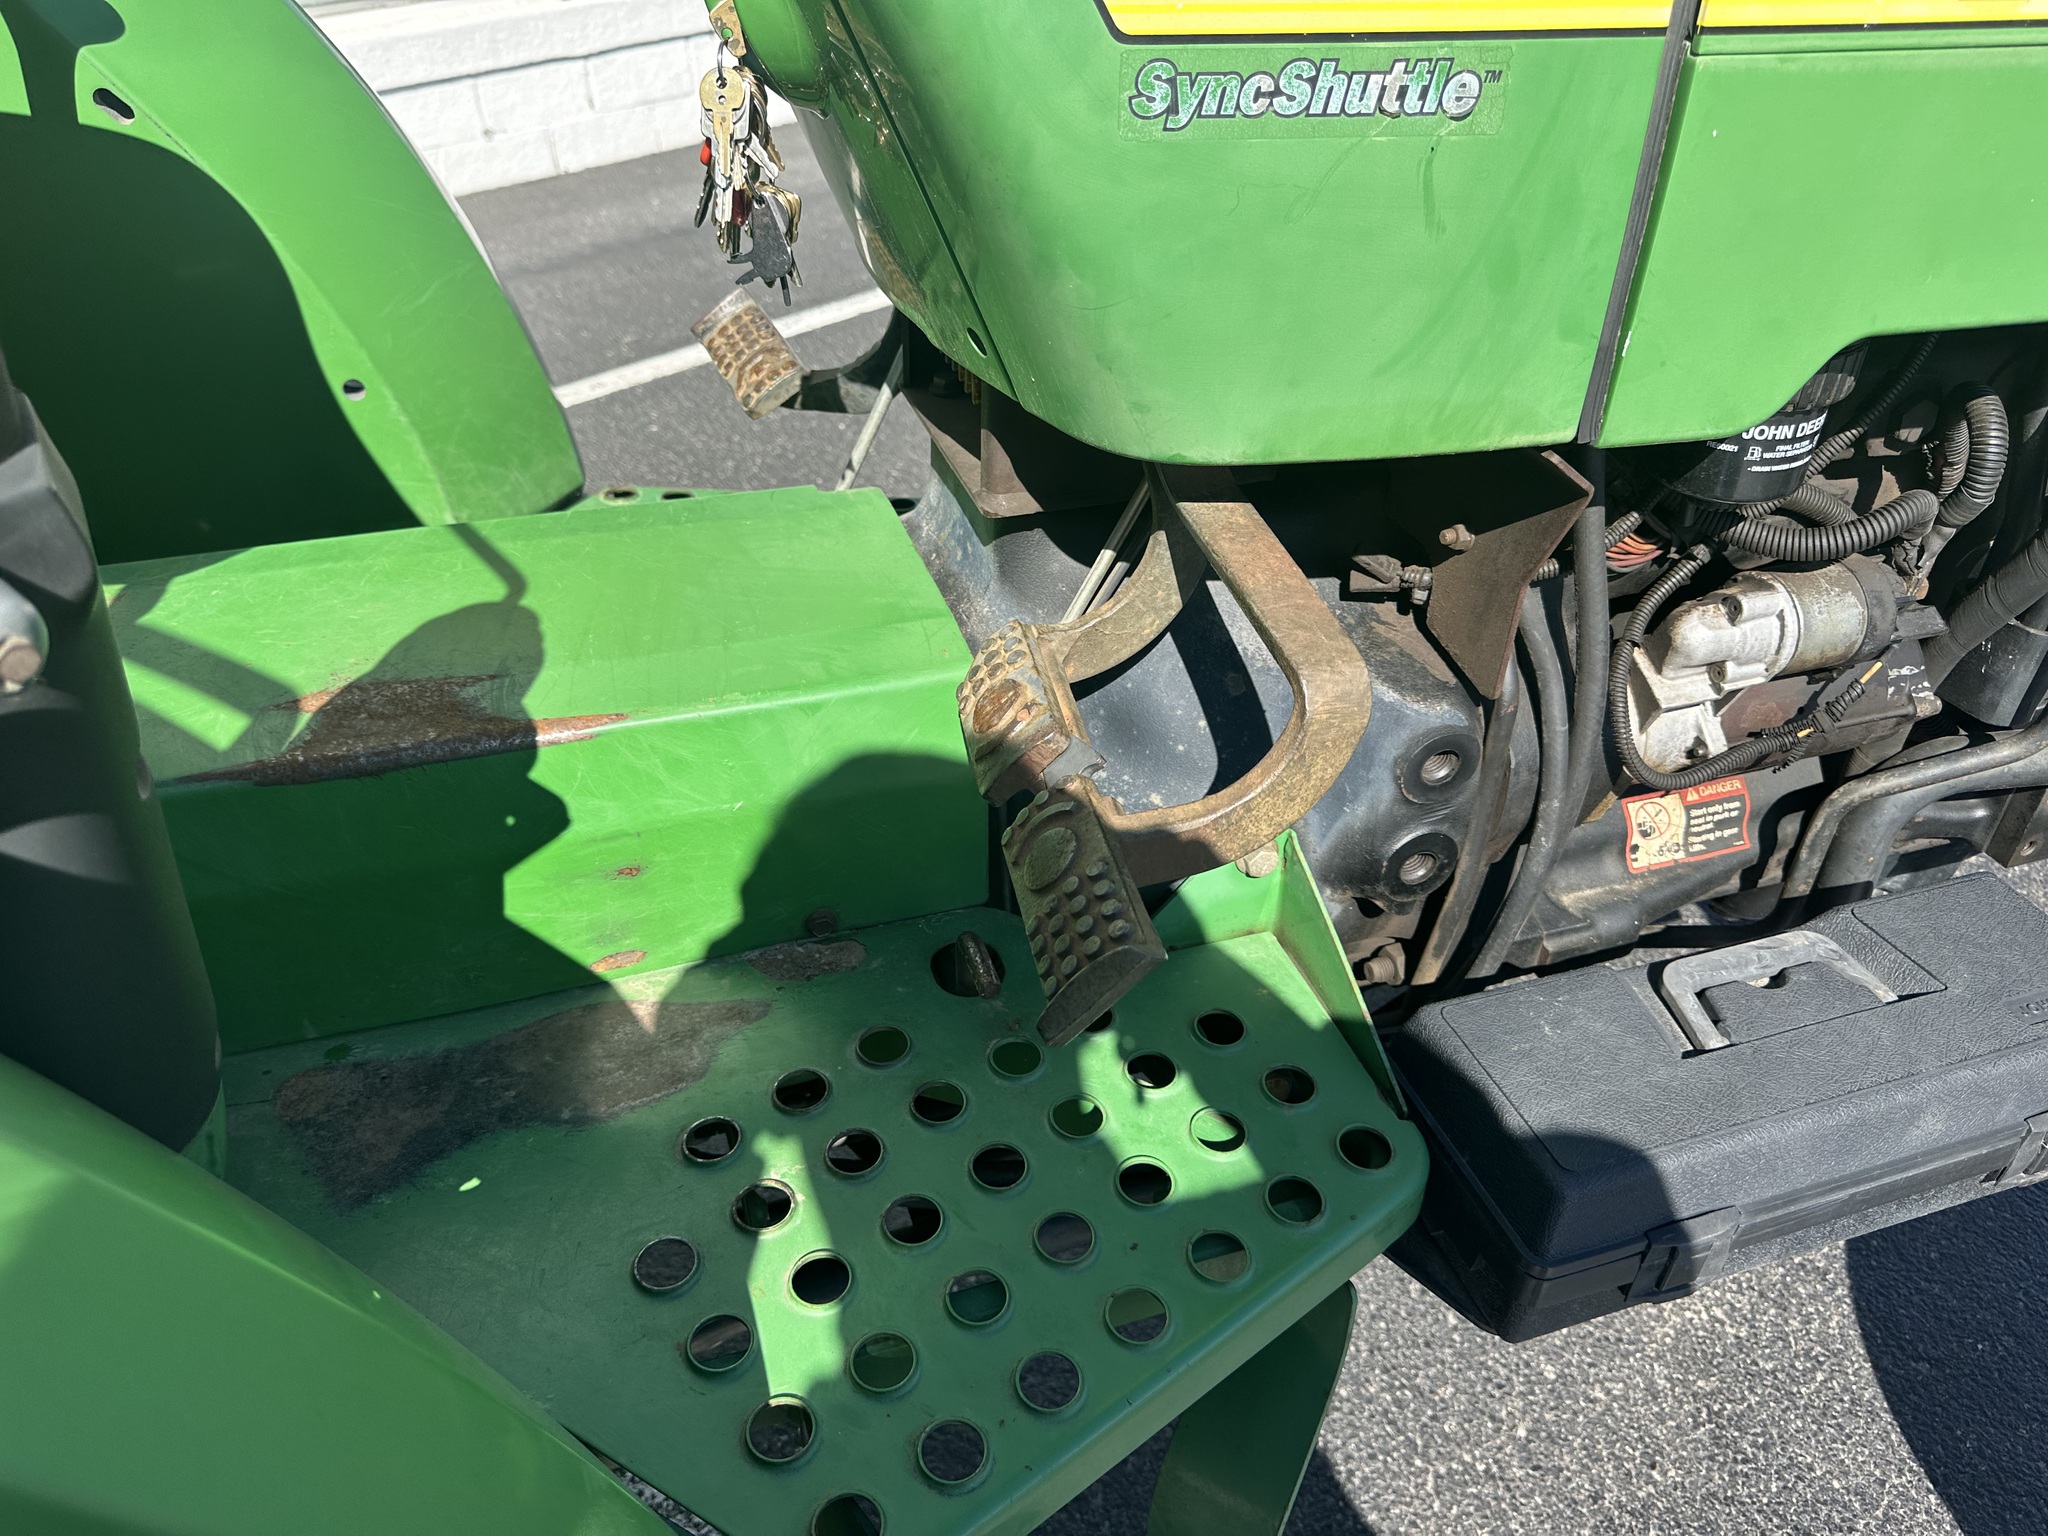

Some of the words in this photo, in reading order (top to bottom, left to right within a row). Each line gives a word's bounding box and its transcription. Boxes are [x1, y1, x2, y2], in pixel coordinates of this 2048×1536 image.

[1129, 57, 1482, 131] SyncShuttle
[1741, 424, 1796, 440] JOHN
[1763, 451, 1785, 459] WATER
[1775, 444, 1793, 452] FINAL
[1699, 780, 1741, 796] DANGER
[1690, 807, 1707, 817] Start
[1707, 804, 1723, 814] only
[1723, 801, 1741, 810] from
[1688, 832, 1715, 844] Starting
